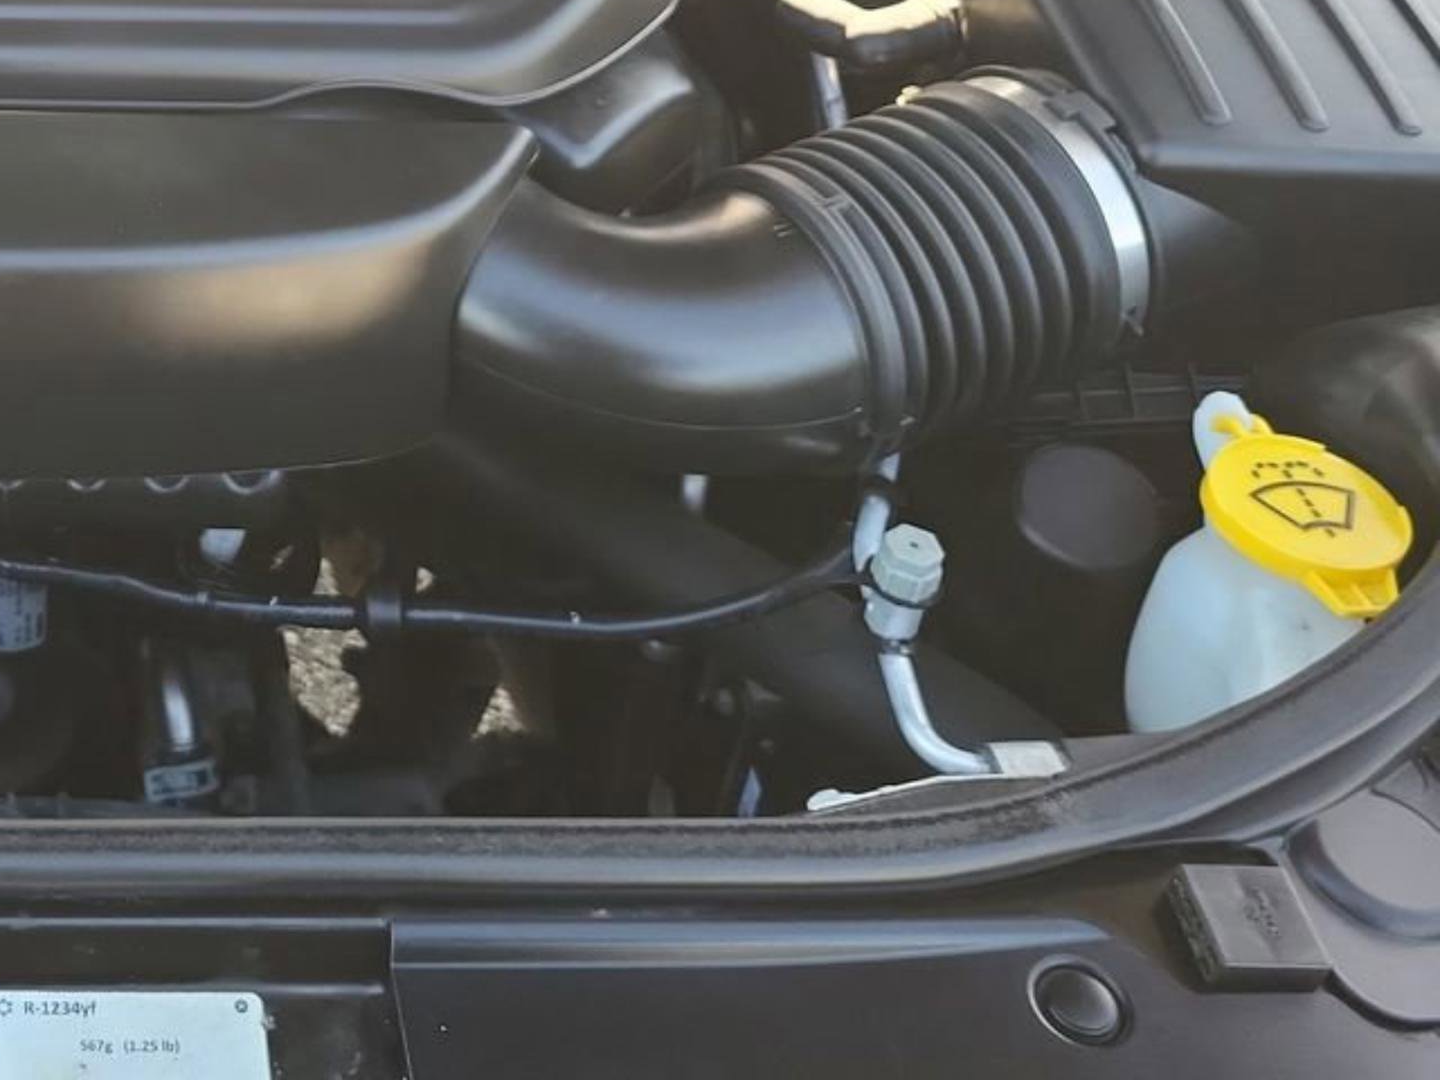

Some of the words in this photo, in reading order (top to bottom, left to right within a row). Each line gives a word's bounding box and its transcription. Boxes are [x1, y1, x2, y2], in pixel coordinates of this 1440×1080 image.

[23, 1000, 97, 1017] R-1234yf
[80, 1040, 113, 1054] 567g
[123, 1040, 159, 1053] (1.25
[161, 1040, 181, 1053] lb)
